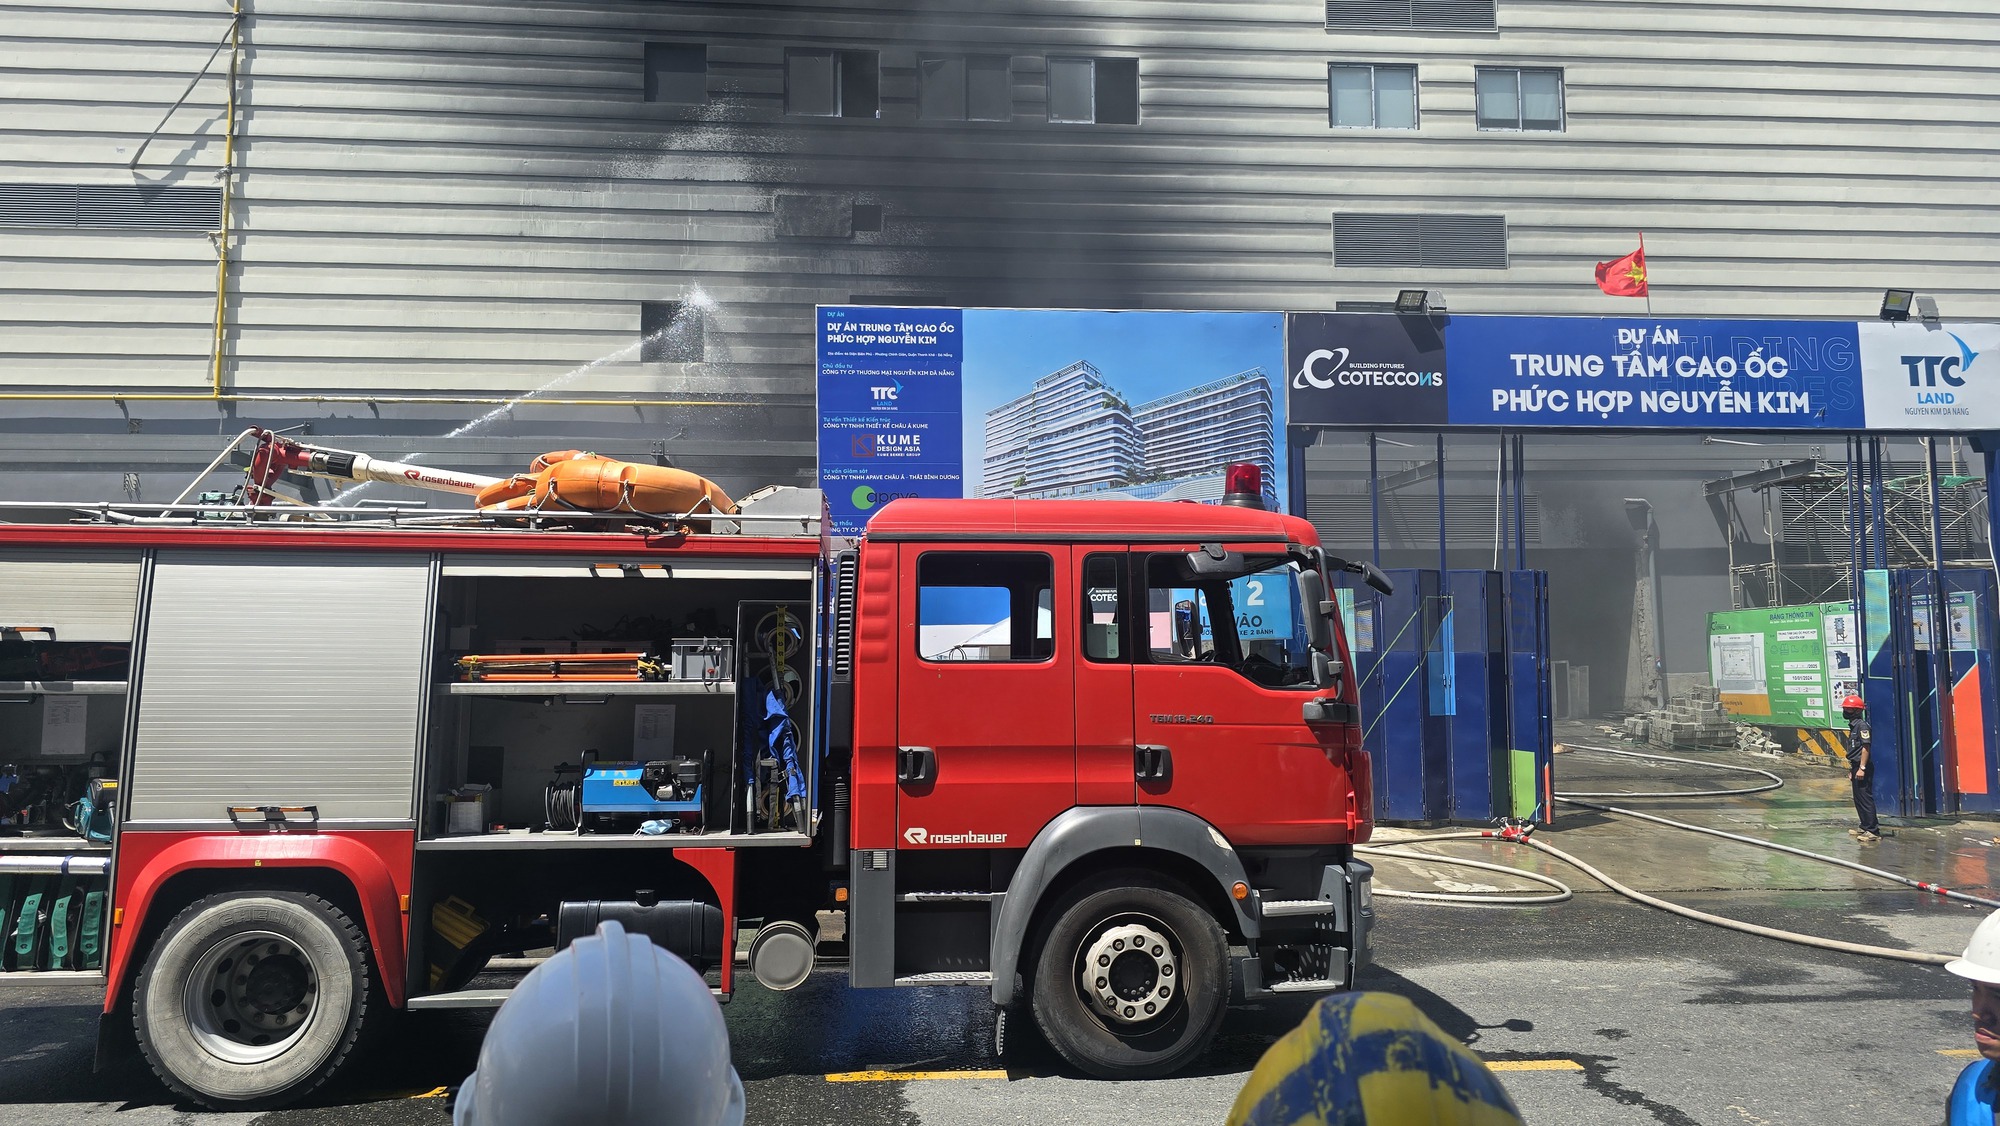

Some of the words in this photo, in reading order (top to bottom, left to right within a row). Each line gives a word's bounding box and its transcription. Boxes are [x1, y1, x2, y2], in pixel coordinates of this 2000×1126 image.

[827, 322, 842, 333] DỰ
[844, 322, 857, 332] ÁN
[859, 324, 892, 332] TRUNG
[894, 322, 914, 332] TÂM
[915, 324, 938, 332] CAO
[939, 322, 955, 332] ỐC
[827, 333, 854, 343] PHỨC
[856, 335, 876, 346] HỢP
[878, 332, 917, 344] NGUYỄN
[918, 336, 937, 344] KIM
[1618, 328, 1646, 349] DỰ
[1652, 325, 1679, 345] ÁN
[1510, 354, 1604, 377] TRUNG
[1611, 350, 1668, 378] TÂM
[1675, 356, 1738, 378] CAO
[1744, 347, 1788, 378] ỐC
[1900, 356, 1966, 387] TTC
[870, 386, 898, 400] TTC
[1492, 384, 1570, 412] PHỨC
[1576, 390, 1633, 419] HỢP
[1640, 380, 1751, 413] NGUYỄN
[1758, 392, 1810, 414] KIM
[1917, 392, 1954, 404] LAND
[1904, 408, 1929, 416] NGUYEN
[1930, 408, 1942, 416] KIM
[1943, 408, 1952, 416] DA
[1952, 408, 1970, 416] NANG
[876, 434, 920, 444] KUME
[421, 476, 476, 488] rosenbauer
[1246, 581, 1264, 606] 2
[930, 831, 1008, 844] rosenbauer
